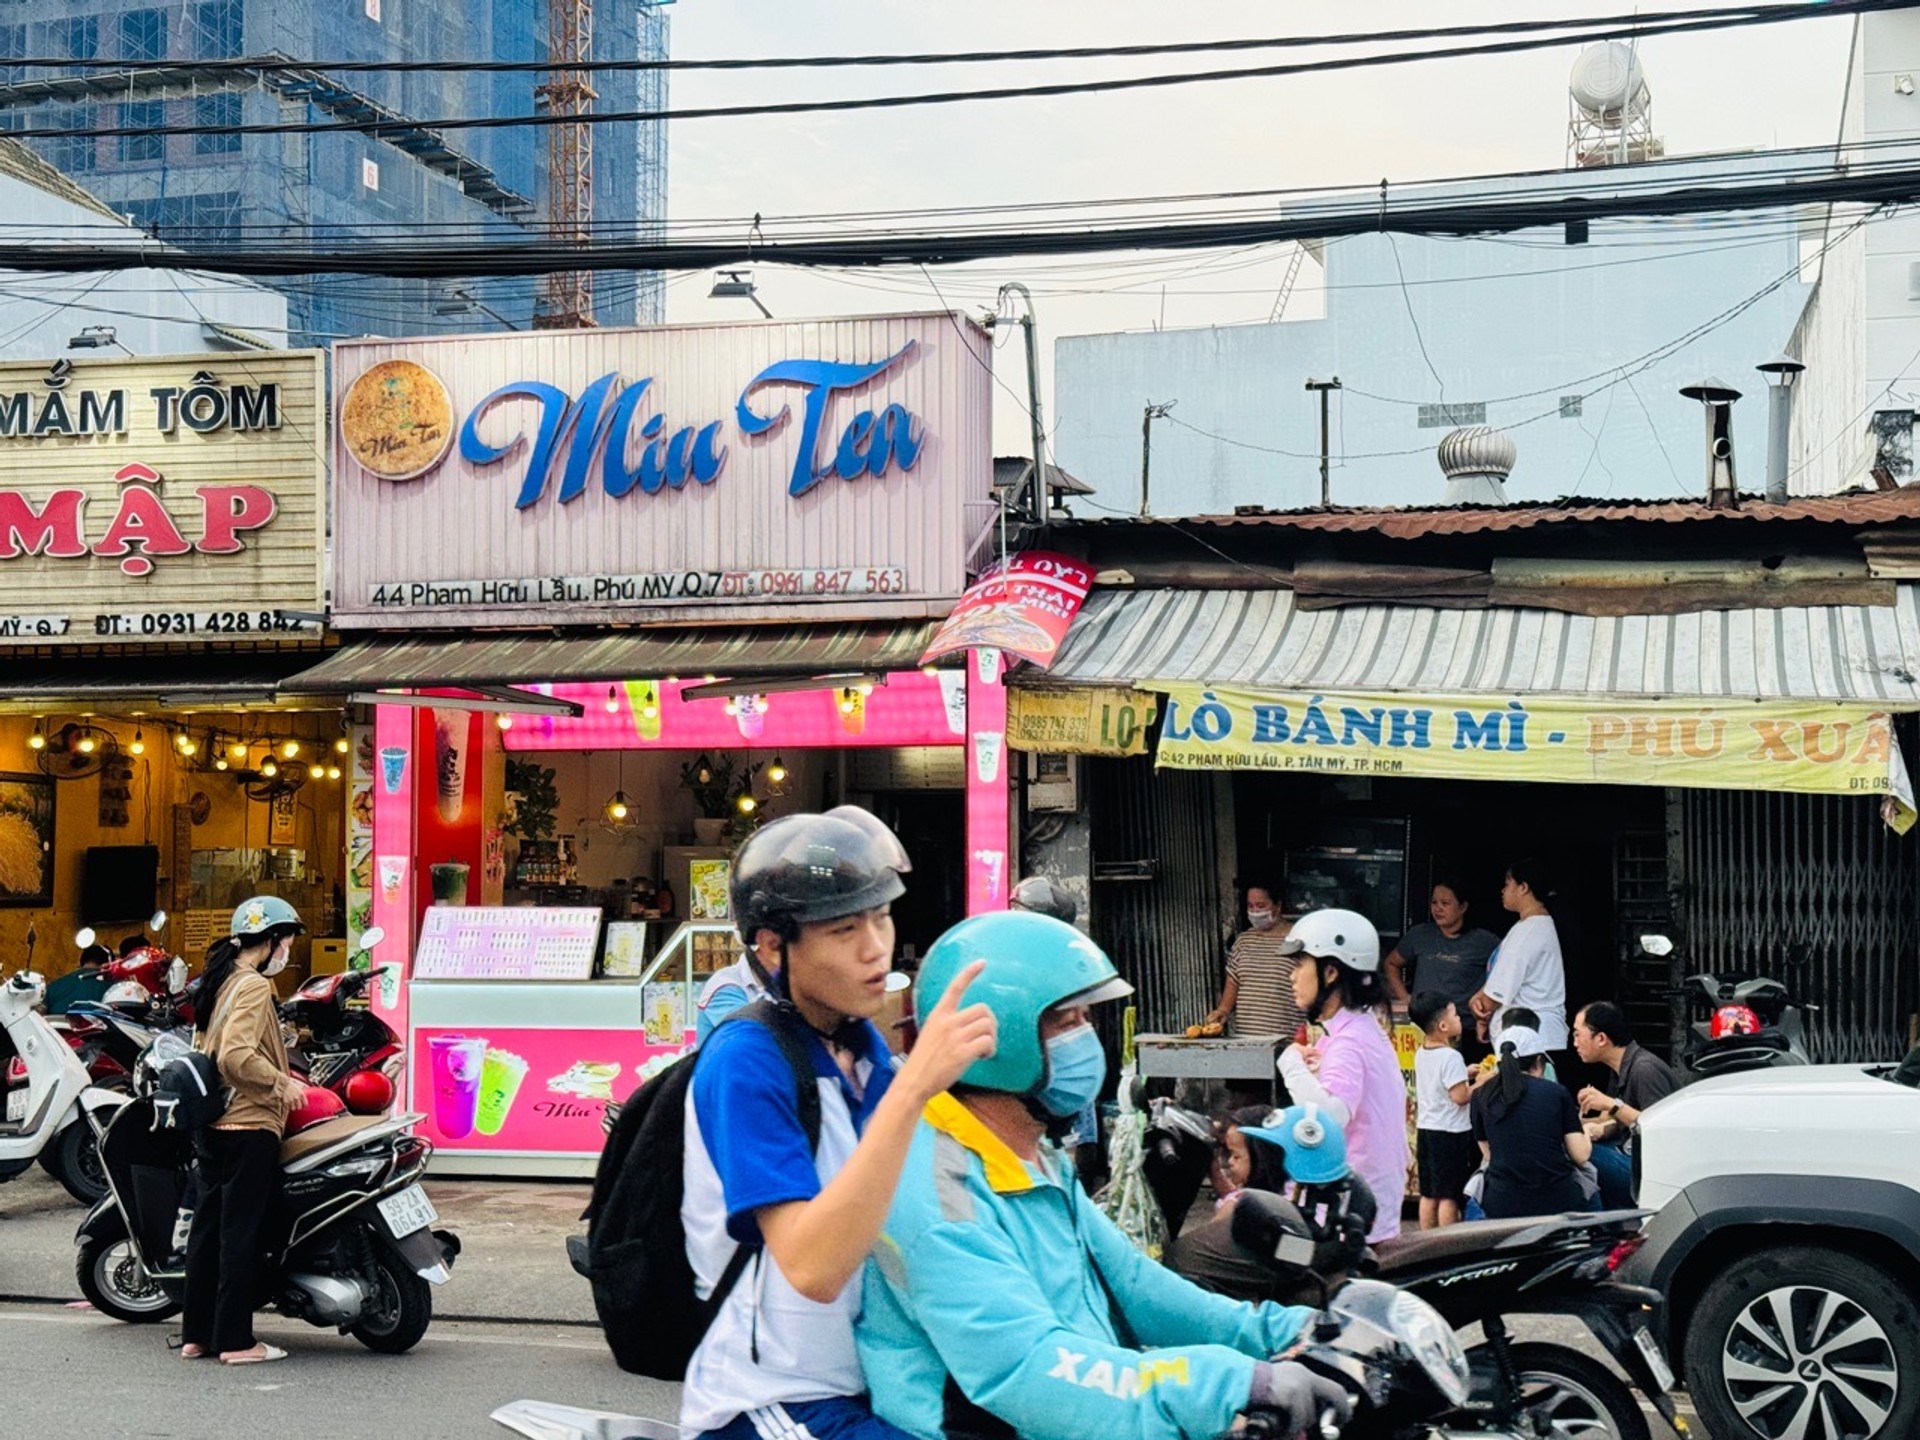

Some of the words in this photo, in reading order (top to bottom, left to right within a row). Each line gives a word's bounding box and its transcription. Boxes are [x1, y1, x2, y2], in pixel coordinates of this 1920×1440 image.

[150, 370, 281, 433] TÔM
[459, 371, 728, 511] Miu
[736, 339, 925, 499] Ten
[0, 462, 275, 576] MẬP
[372, 584, 404, 606] 44
[594, 577, 635, 601] Phú
[760, 571, 803, 595] 0961
[814, 570, 853, 595] 847
[865, 569, 903, 594] 563
[1018, 595, 1070, 620] MINI
[141, 613, 195, 633] 0931
[206, 612, 250, 632] 428
[1163, 692, 1234, 742] LÒ
[1252, 695, 1434, 749] BÁNH
[1452, 700, 1529, 752] MÌ
[1586, 707, 1727, 758] PHÚ
[1171, 753, 1185, 765] 42
[1285, 756, 1294, 768] P.
[1299, 755, 1323, 769] TÂN
[1374, 759, 1403, 771] HCM
